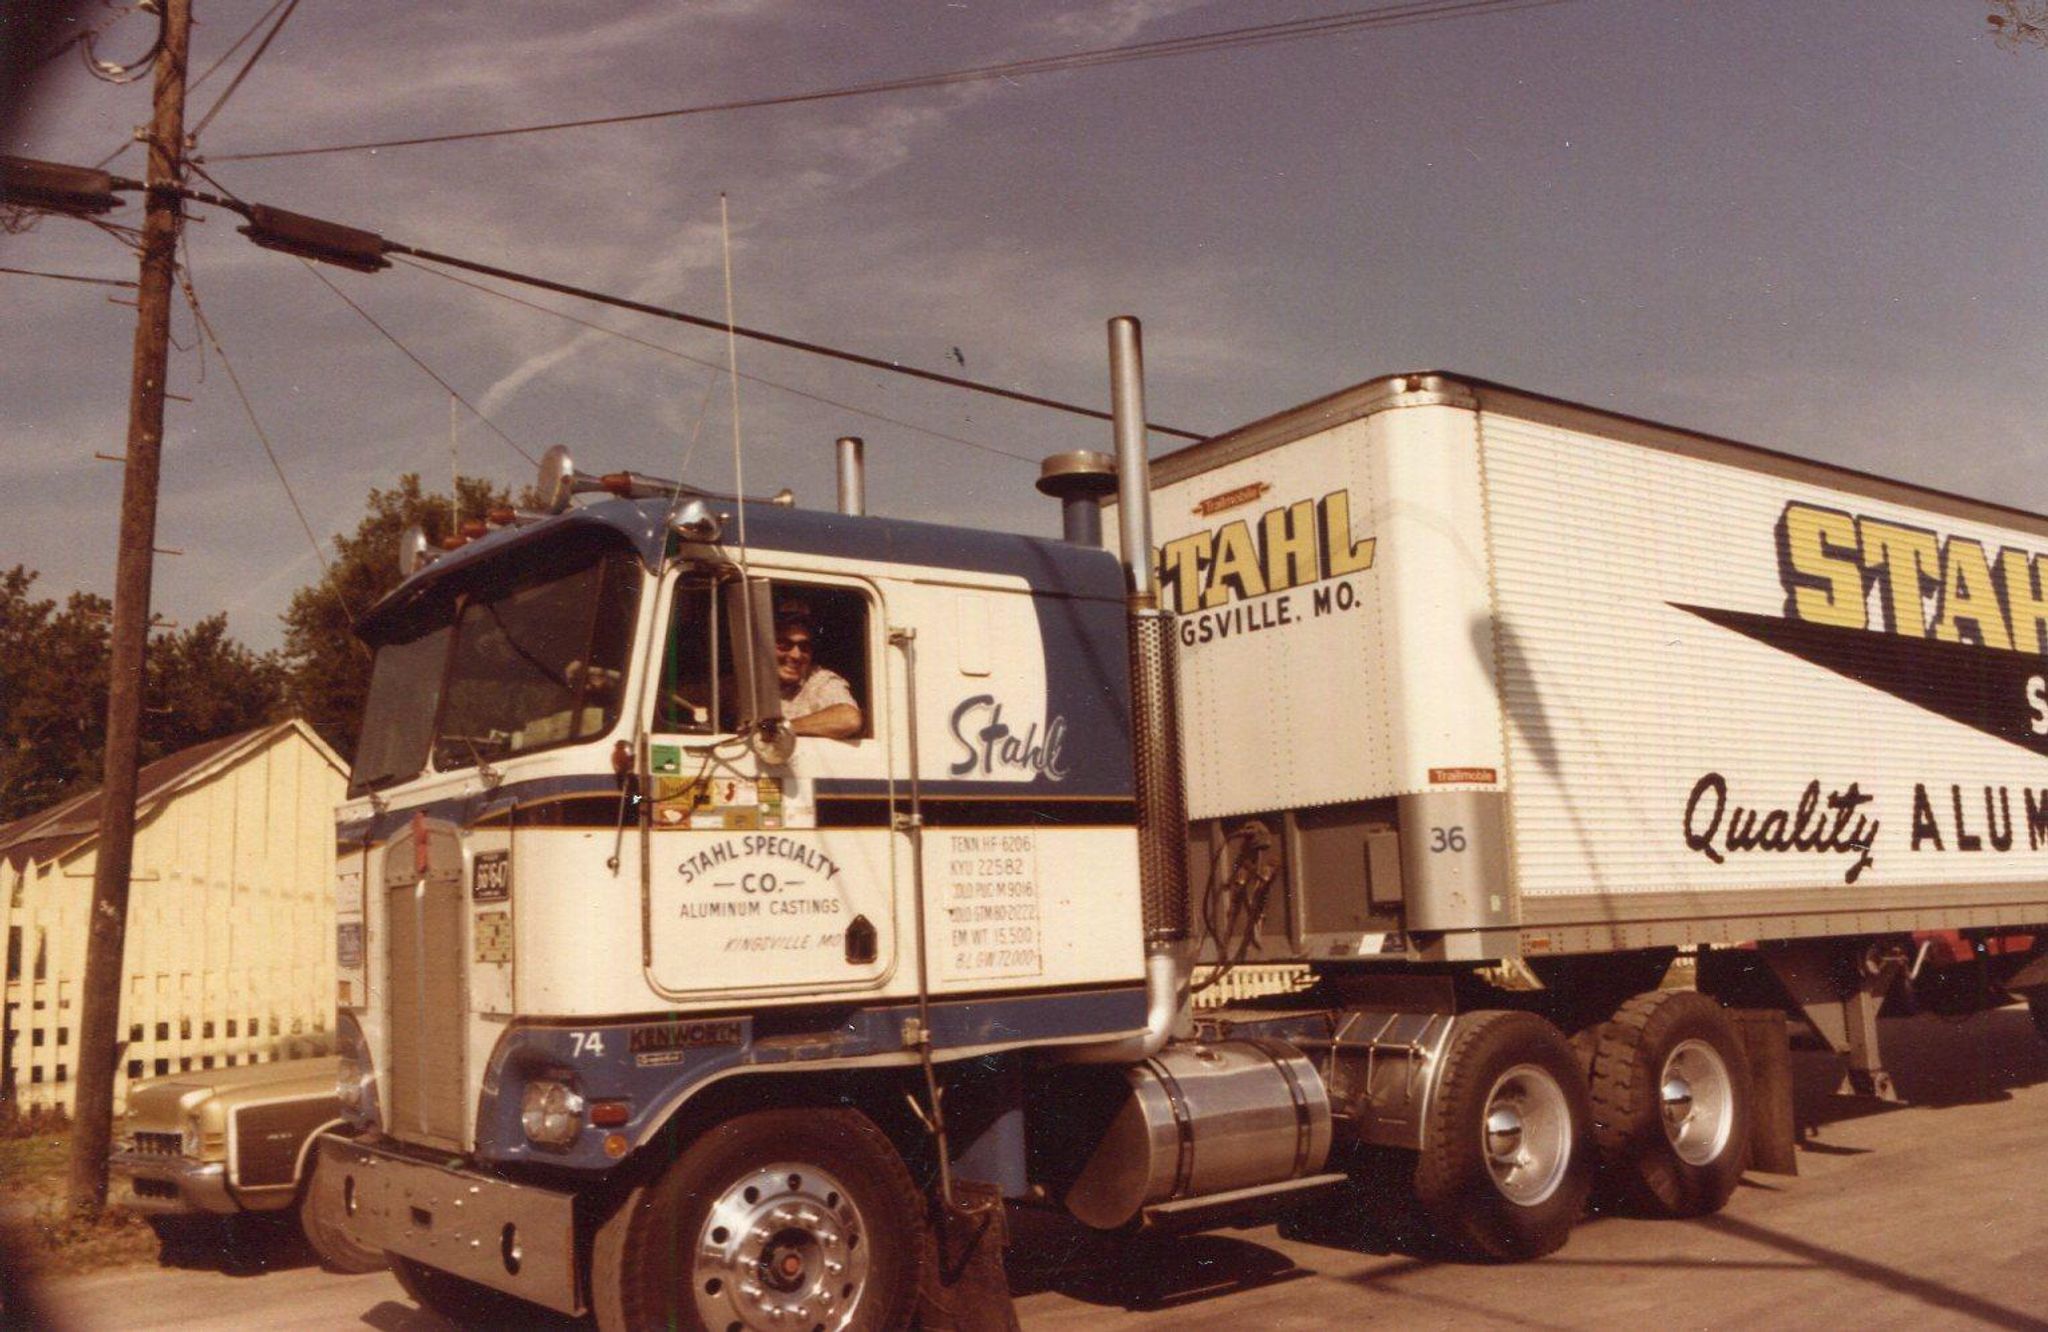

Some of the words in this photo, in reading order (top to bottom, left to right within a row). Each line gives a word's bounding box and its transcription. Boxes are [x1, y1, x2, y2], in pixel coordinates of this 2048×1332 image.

[1313, 581, 1361, 617] MO.
[949, 693, 1070, 780] Stahl
[1430, 826, 1467, 853] 36
[1684, 772, 1879, 884] Quality
[678, 840, 739, 883] STAHL
[743, 836, 841, 881] SPECIALTY
[977, 857, 1024, 876] 22582
[741, 873, 784, 893] CO.
[680, 901, 761, 918] ALUMINUM
[770, 899, 840, 916] CASTINGS
[725, 935, 811, 952] KINGSVILLE
[569, 1032, 606, 1058] 74
